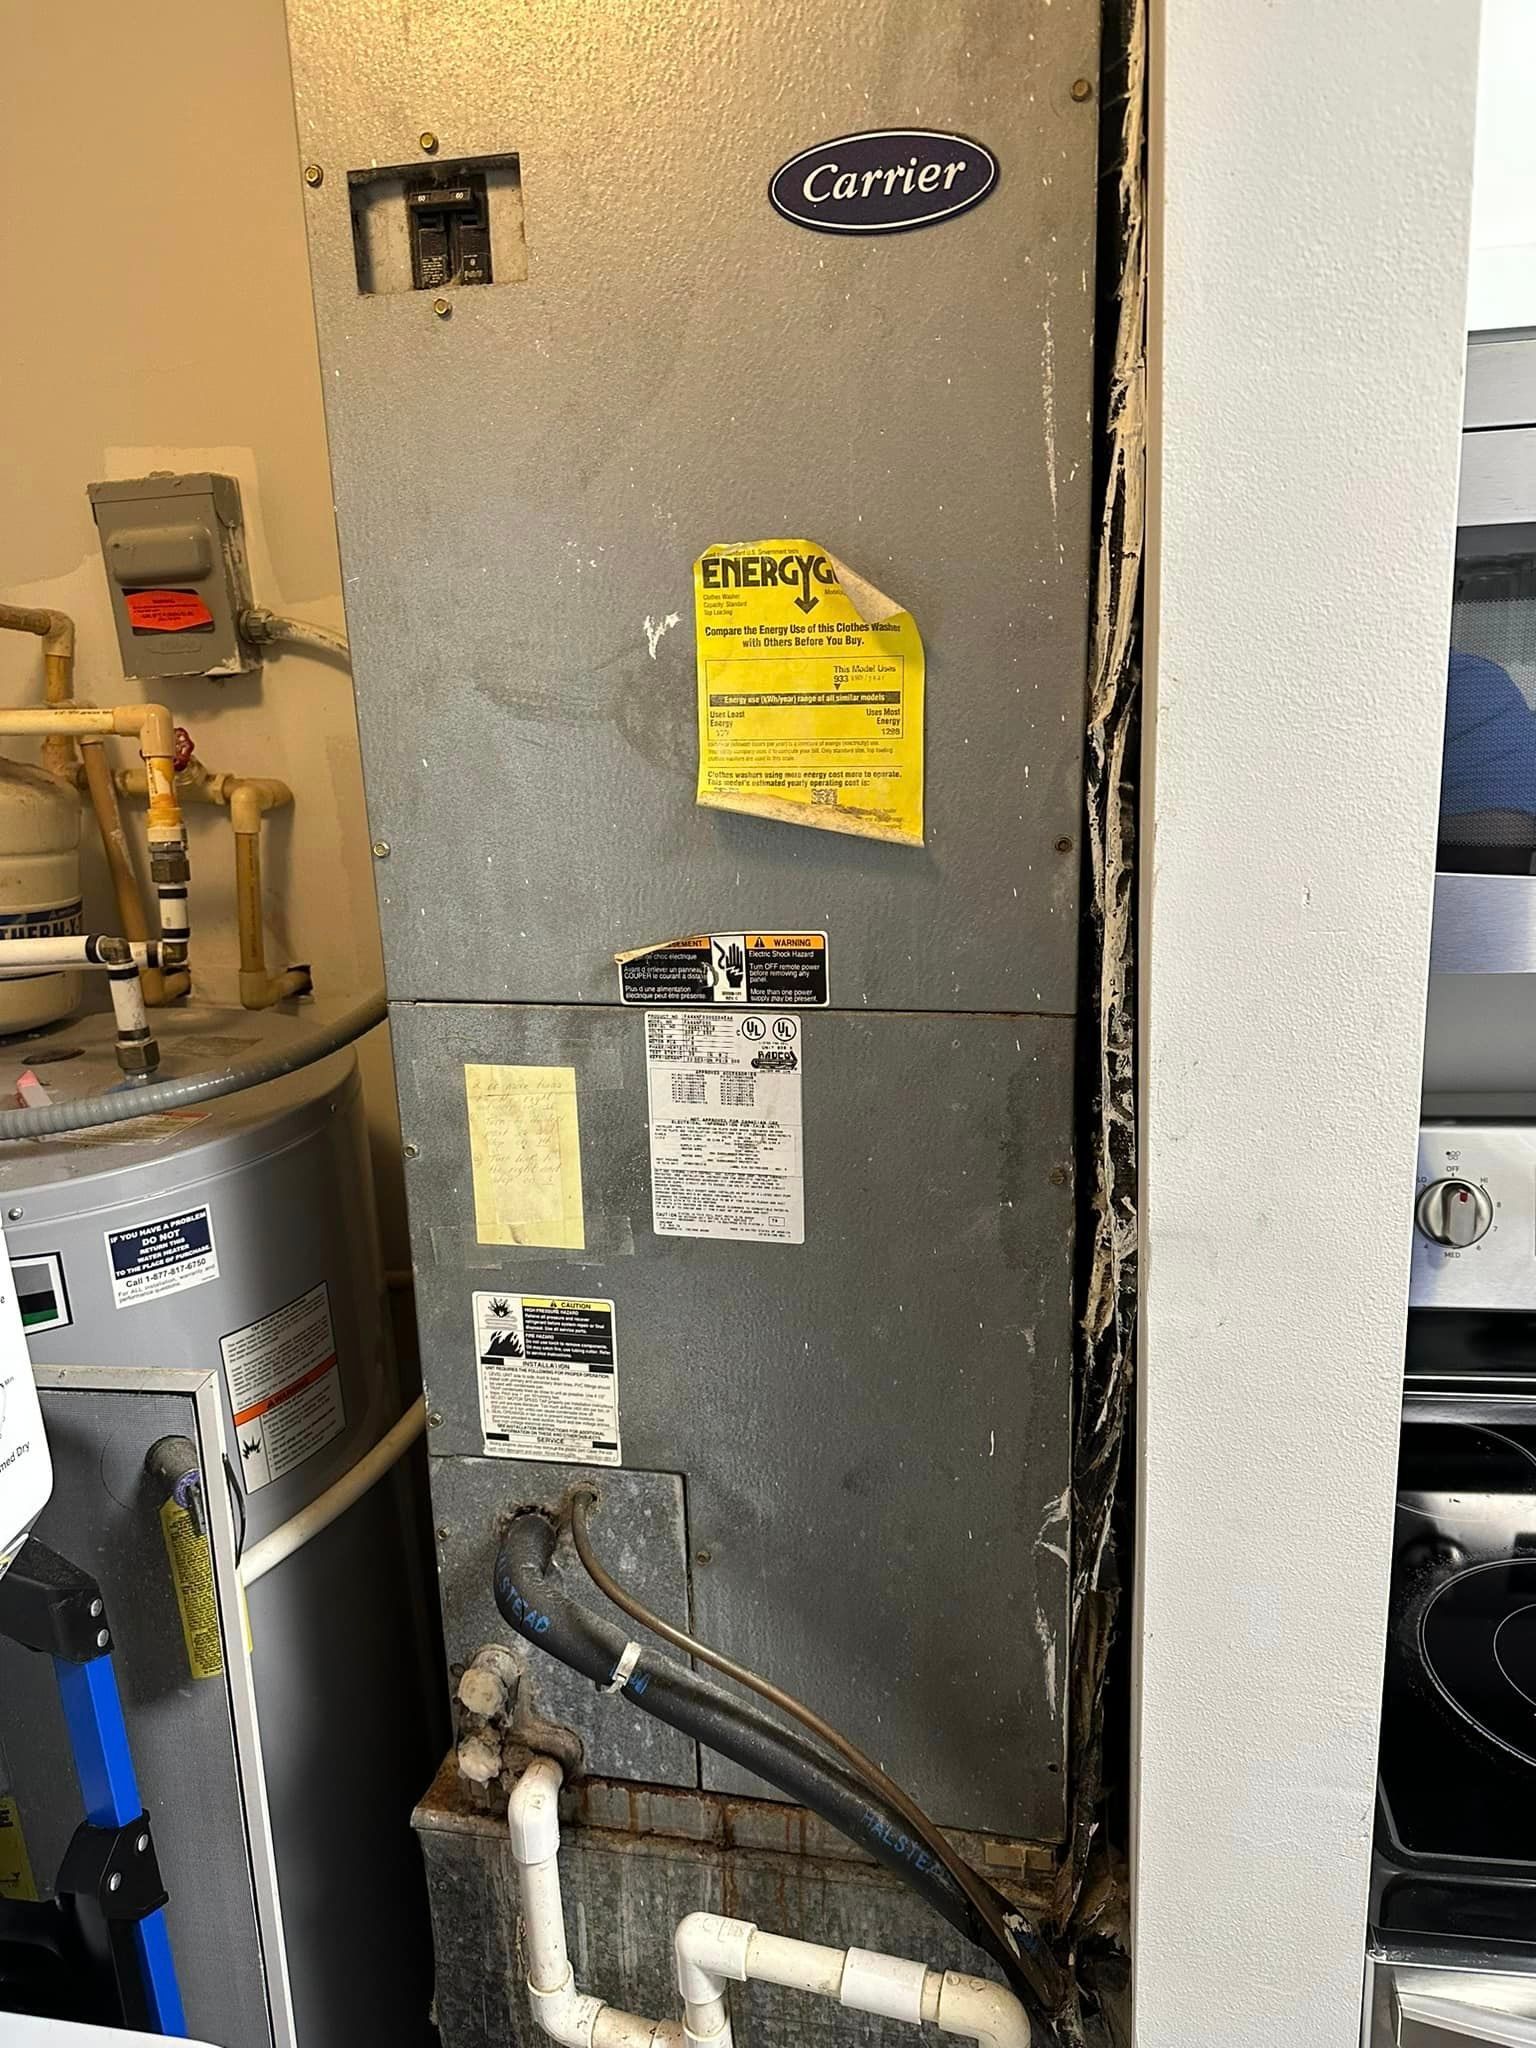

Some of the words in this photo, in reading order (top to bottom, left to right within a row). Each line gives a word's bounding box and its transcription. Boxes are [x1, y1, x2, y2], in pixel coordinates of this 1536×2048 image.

[802, 157, 967, 203] Carrier
[706, 626, 742, 637] Compare
[744, 626, 758, 635] the
[760, 625, 788, 636] Energy
[790, 624, 806, 634] Use
[808, 624, 816, 632] of
[818, 623, 834, 632] this
[836, 622, 870, 632] Clothes
[743, 638, 761, 648] with
[764, 638, 792, 647] Others
[795, 636, 824, 646] Before
[826, 636, 842, 646] You
[846, 636, 864, 647] Buy.
[834, 665, 850, 674] This
[724, 696, 747, 705] Energy
[797, 695, 816, 703] range
[836, 694, 860, 702] similar
[866, 708, 882, 716] Uses
[884, 708, 900, 716] Most
[710, 720, 733, 728] Energy
[876, 717, 900, 726] Energy
[764, 772, 782, 780] using
[787, 780, 808, 788] yearly
[774, 939, 812, 947] WARNING
[120, 1232, 138, 1241] YOU
[140, 1226, 162, 1236] HAVE
[170, 1212, 206, 1228] PROBLEM
[142, 1237, 157, 1246] DO
[160, 1229, 180, 1242] NOT
[140, 1243, 168, 1254] RETURN
[170, 1238, 186, 1247] THIS
[138, 1252, 162, 1263] WATER
[163, 1244, 190, 1256] HEATER
[126, 1264, 141, 1274] THE
[142, 1259, 164, 1270] PLACE
[165, 1255, 174, 1263] OF
[126, 1277, 144, 1288] Call
[120, 1290, 154, 1304] performance
[522, 1361, 570, 1370] INSTALLATION
[537, 1436, 564, 1445] SERVICE
[16, 1442, 30, 1458] Dry
